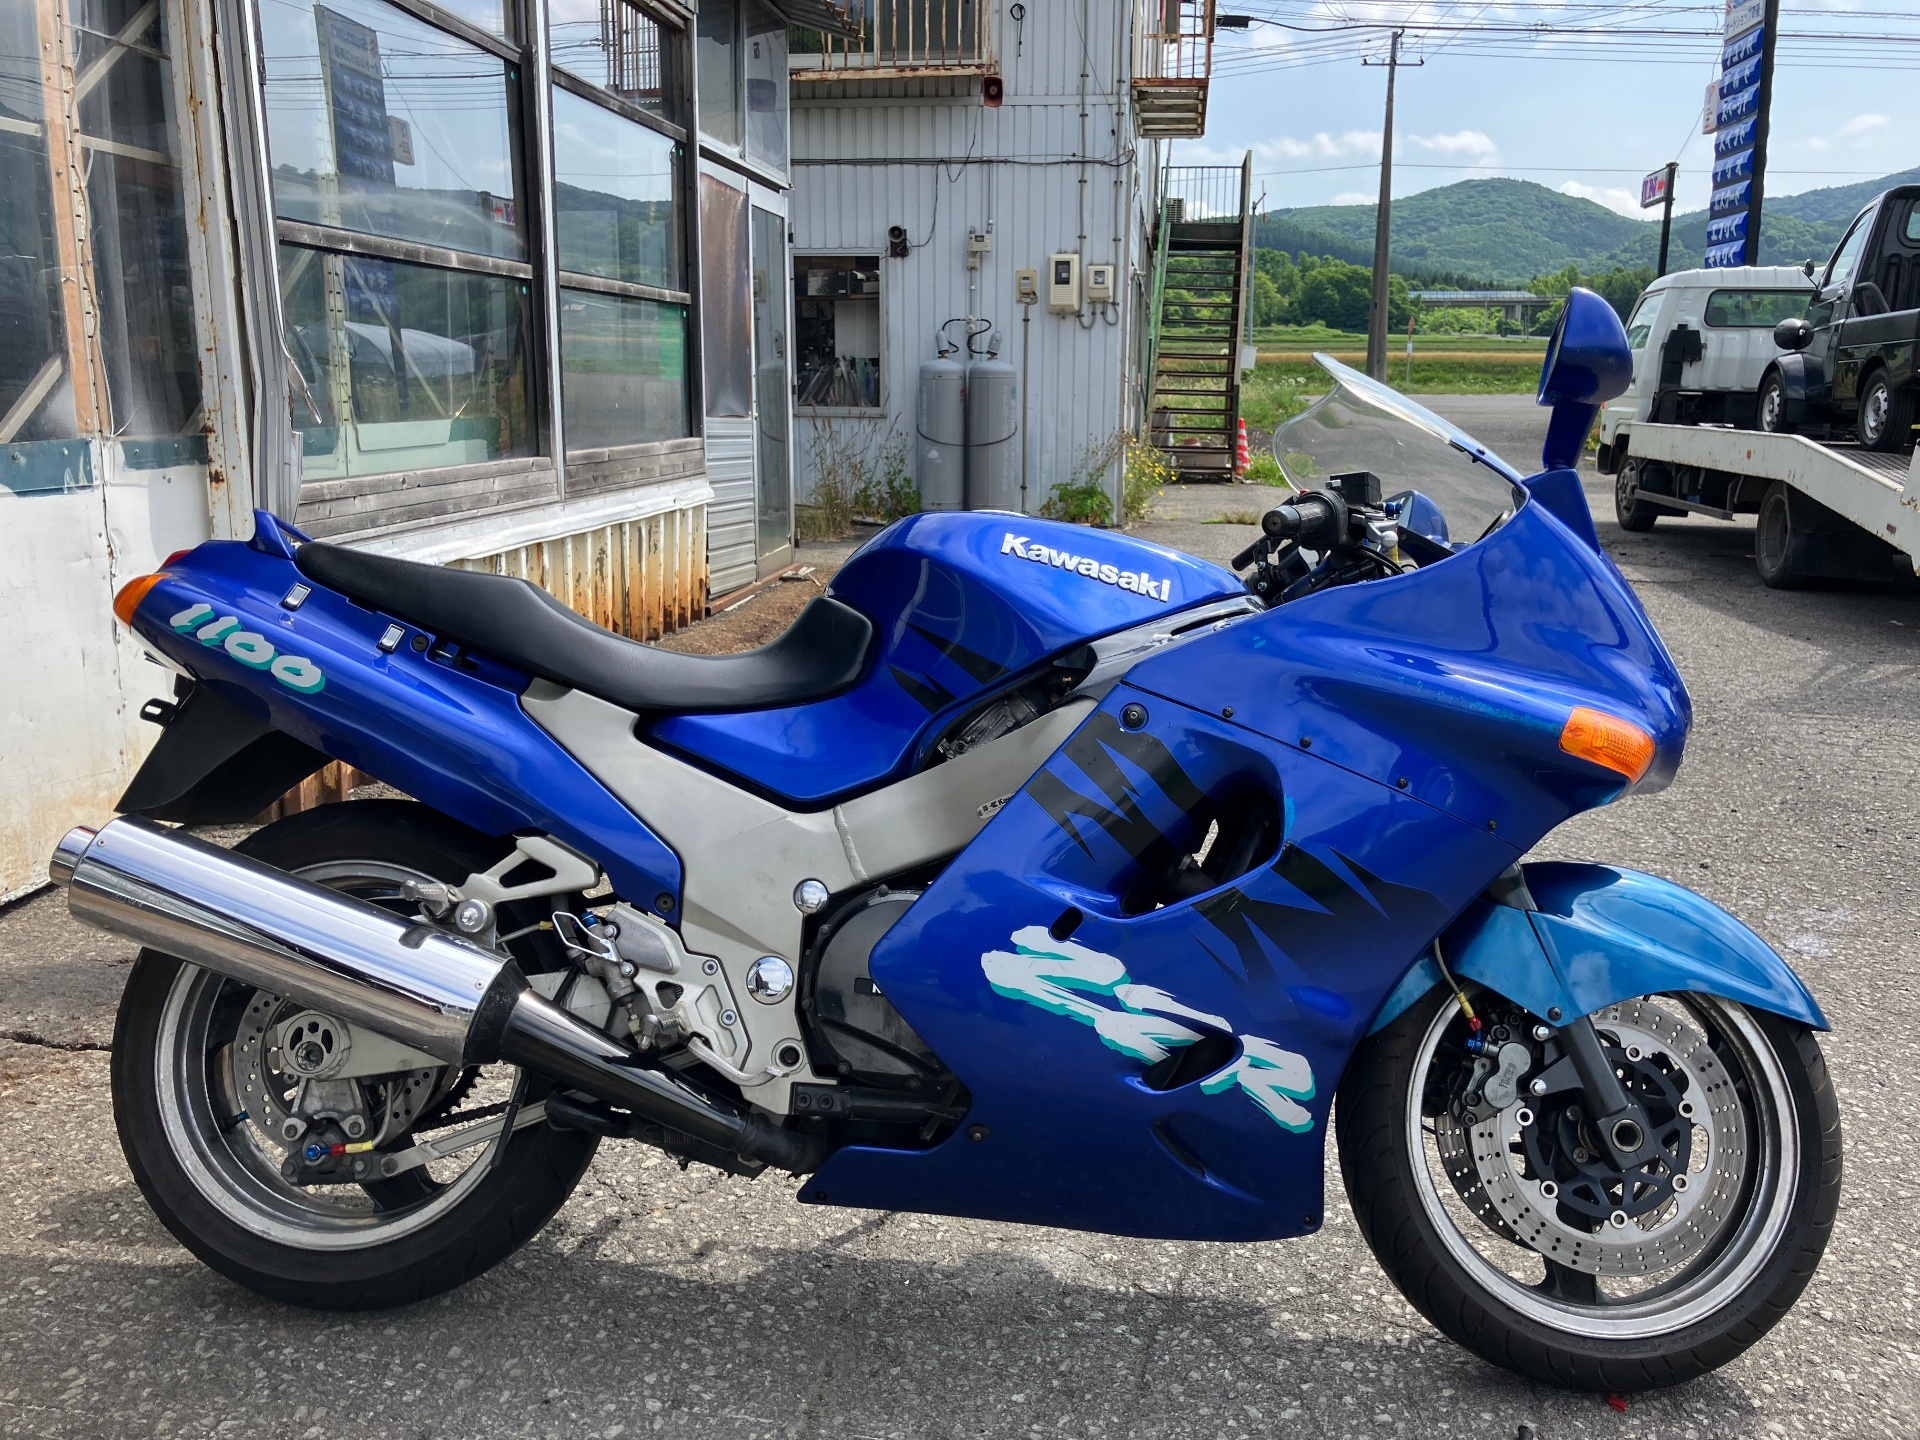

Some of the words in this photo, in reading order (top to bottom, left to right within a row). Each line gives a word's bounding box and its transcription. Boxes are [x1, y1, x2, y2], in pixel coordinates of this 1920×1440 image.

[1723, 65, 1750, 94] アルト
[1718, 125, 1746, 152] スイフト
[1000, 532, 1171, 603] Kawasaki
[170, 603, 326, 694] 1100
